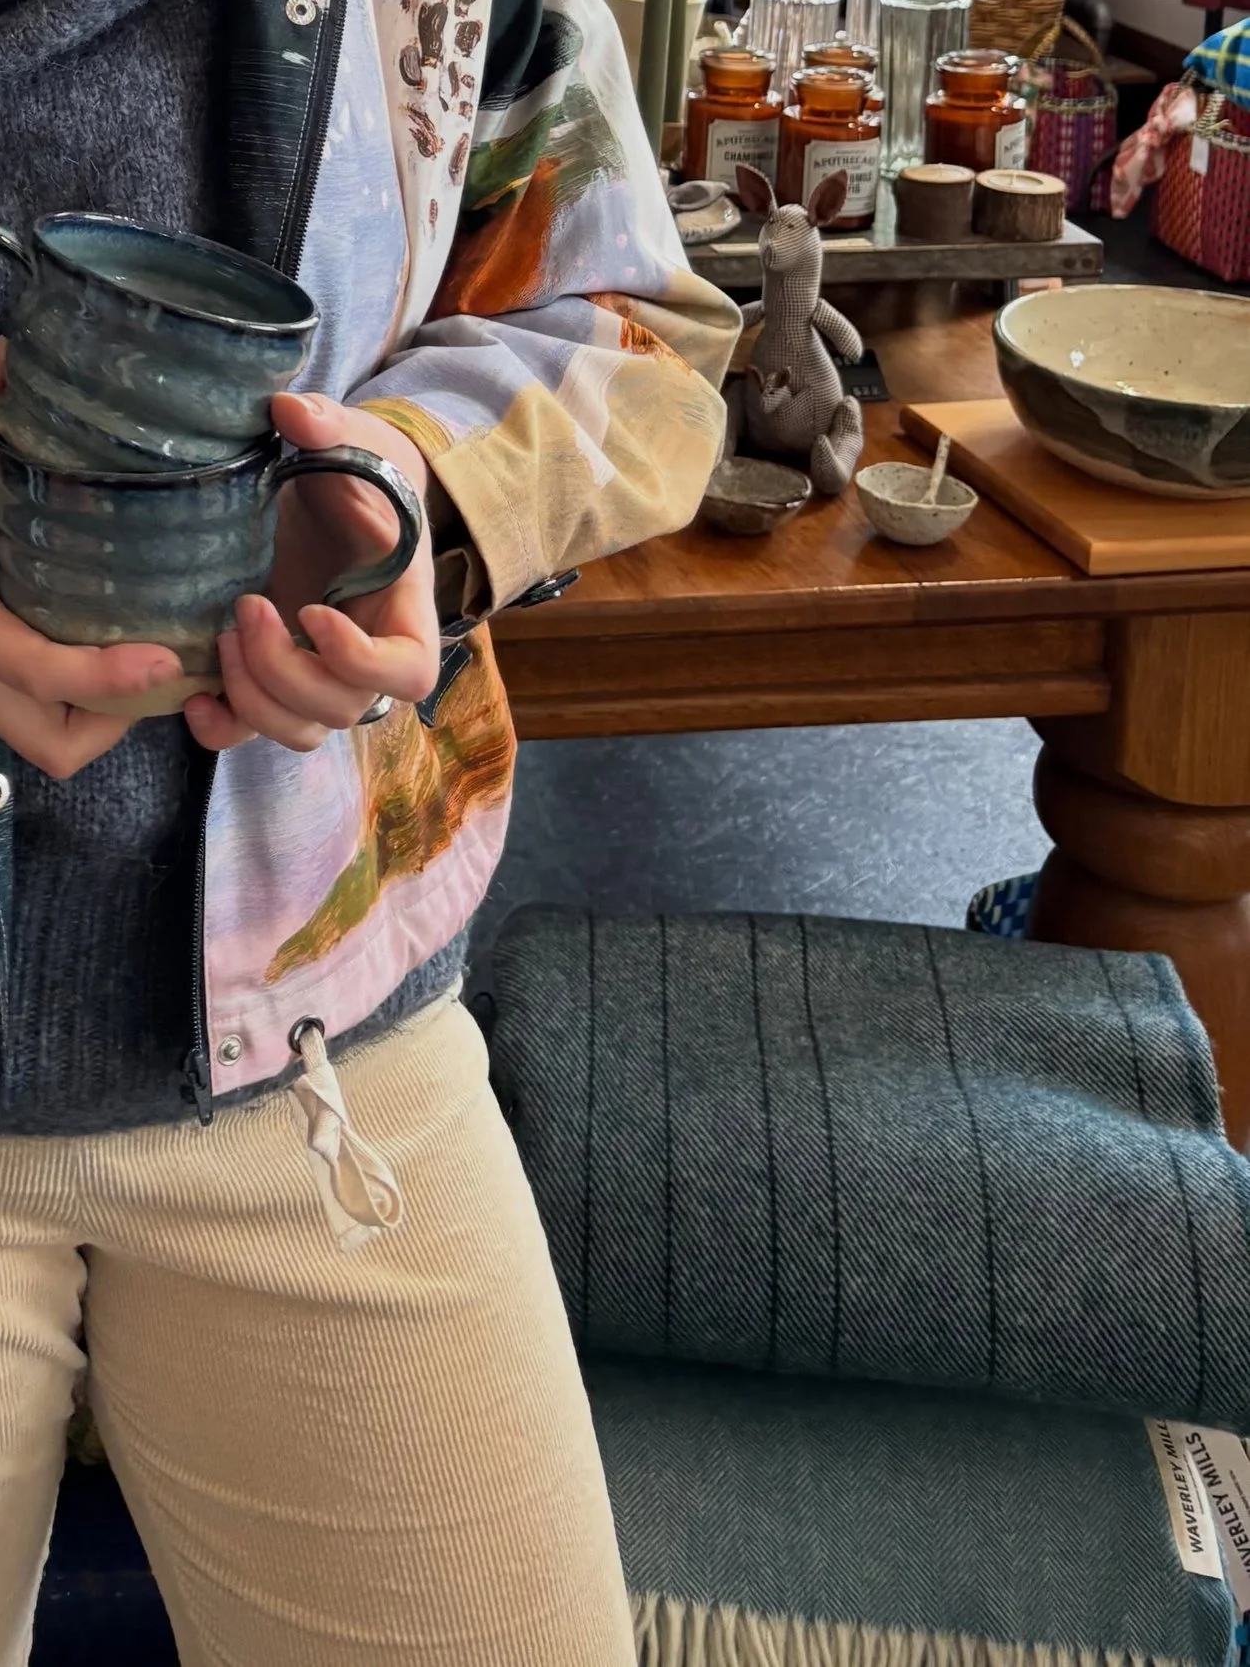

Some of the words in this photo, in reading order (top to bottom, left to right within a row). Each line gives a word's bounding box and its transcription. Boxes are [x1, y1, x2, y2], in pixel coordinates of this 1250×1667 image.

[1185, 1432, 1222, 1488] MILLS
[1170, 1461, 1204, 1553] WAVERLEY
[1212, 1494, 1250, 1578] AVERLEY
